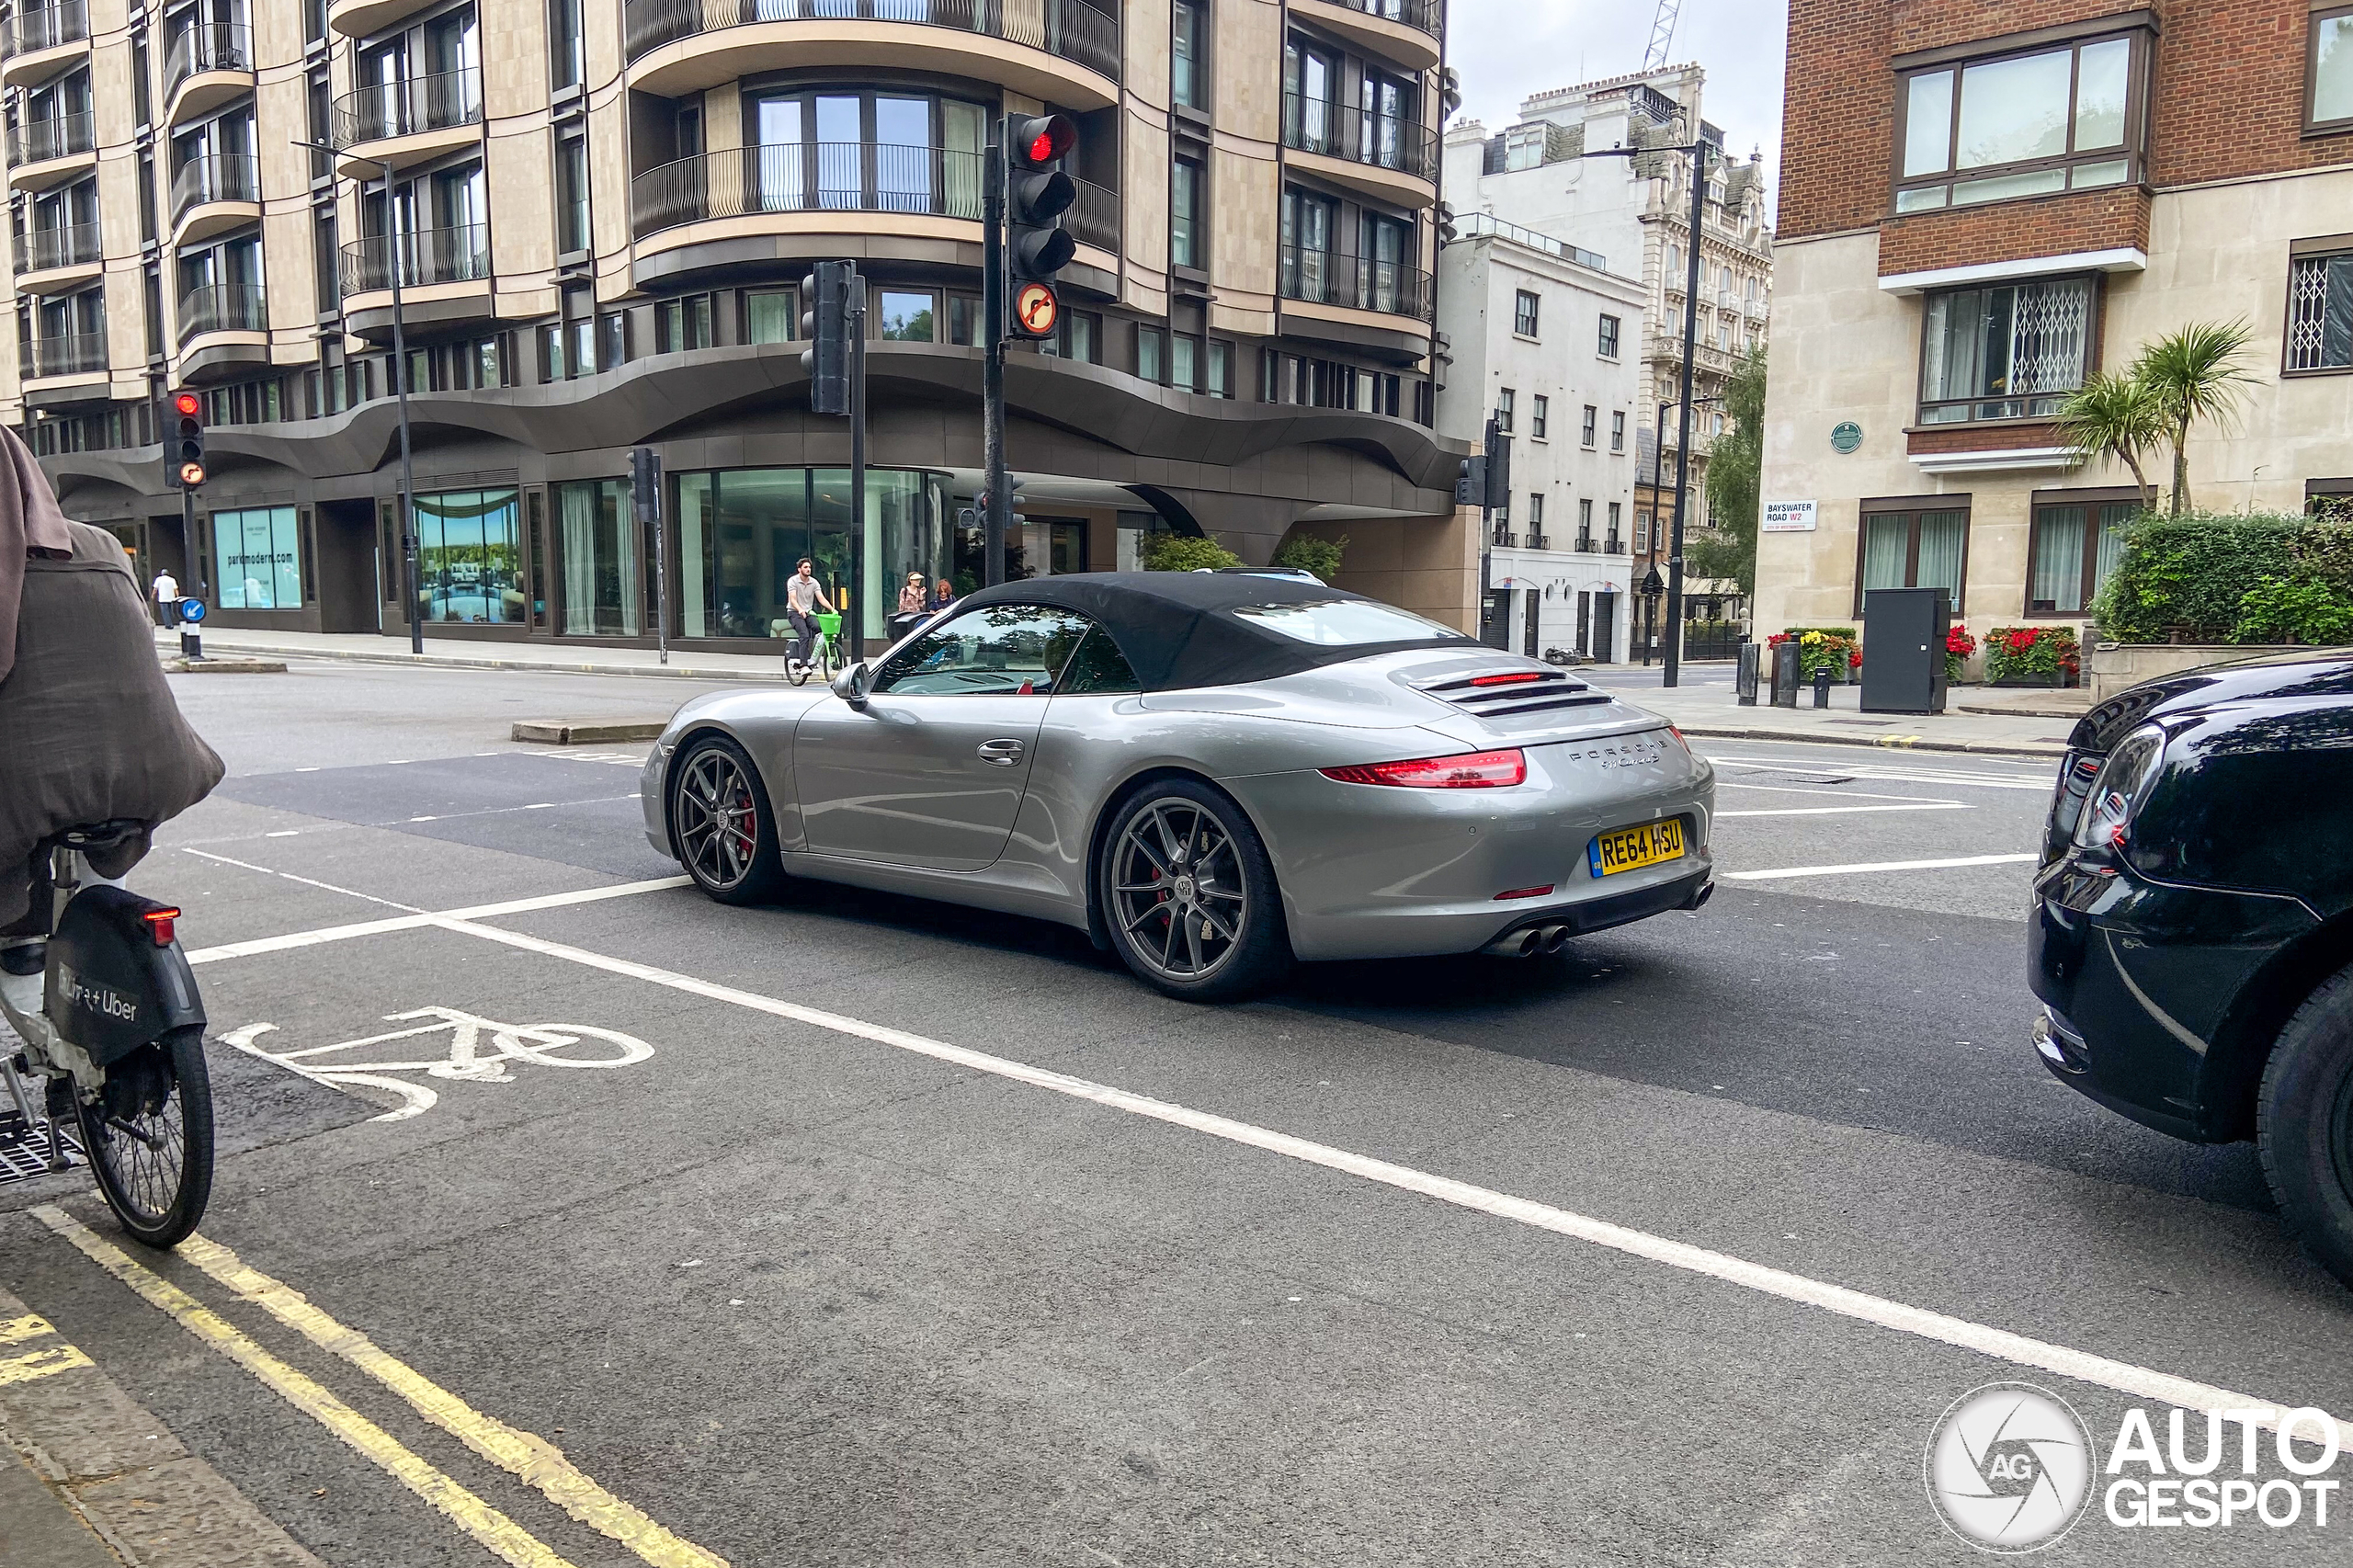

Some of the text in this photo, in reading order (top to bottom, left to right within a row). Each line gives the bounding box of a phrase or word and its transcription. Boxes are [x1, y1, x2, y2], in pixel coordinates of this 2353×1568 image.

[1768, 504, 1812, 512] BAYSWATER
[227, 551, 293, 568] parkmodern.com
[1569, 740, 1667, 761] PORSCHE
[1601, 760, 1617, 769] 911
[1601, 824, 1680, 868] RE64 HSU
[102, 989, 137, 1022] Uber
